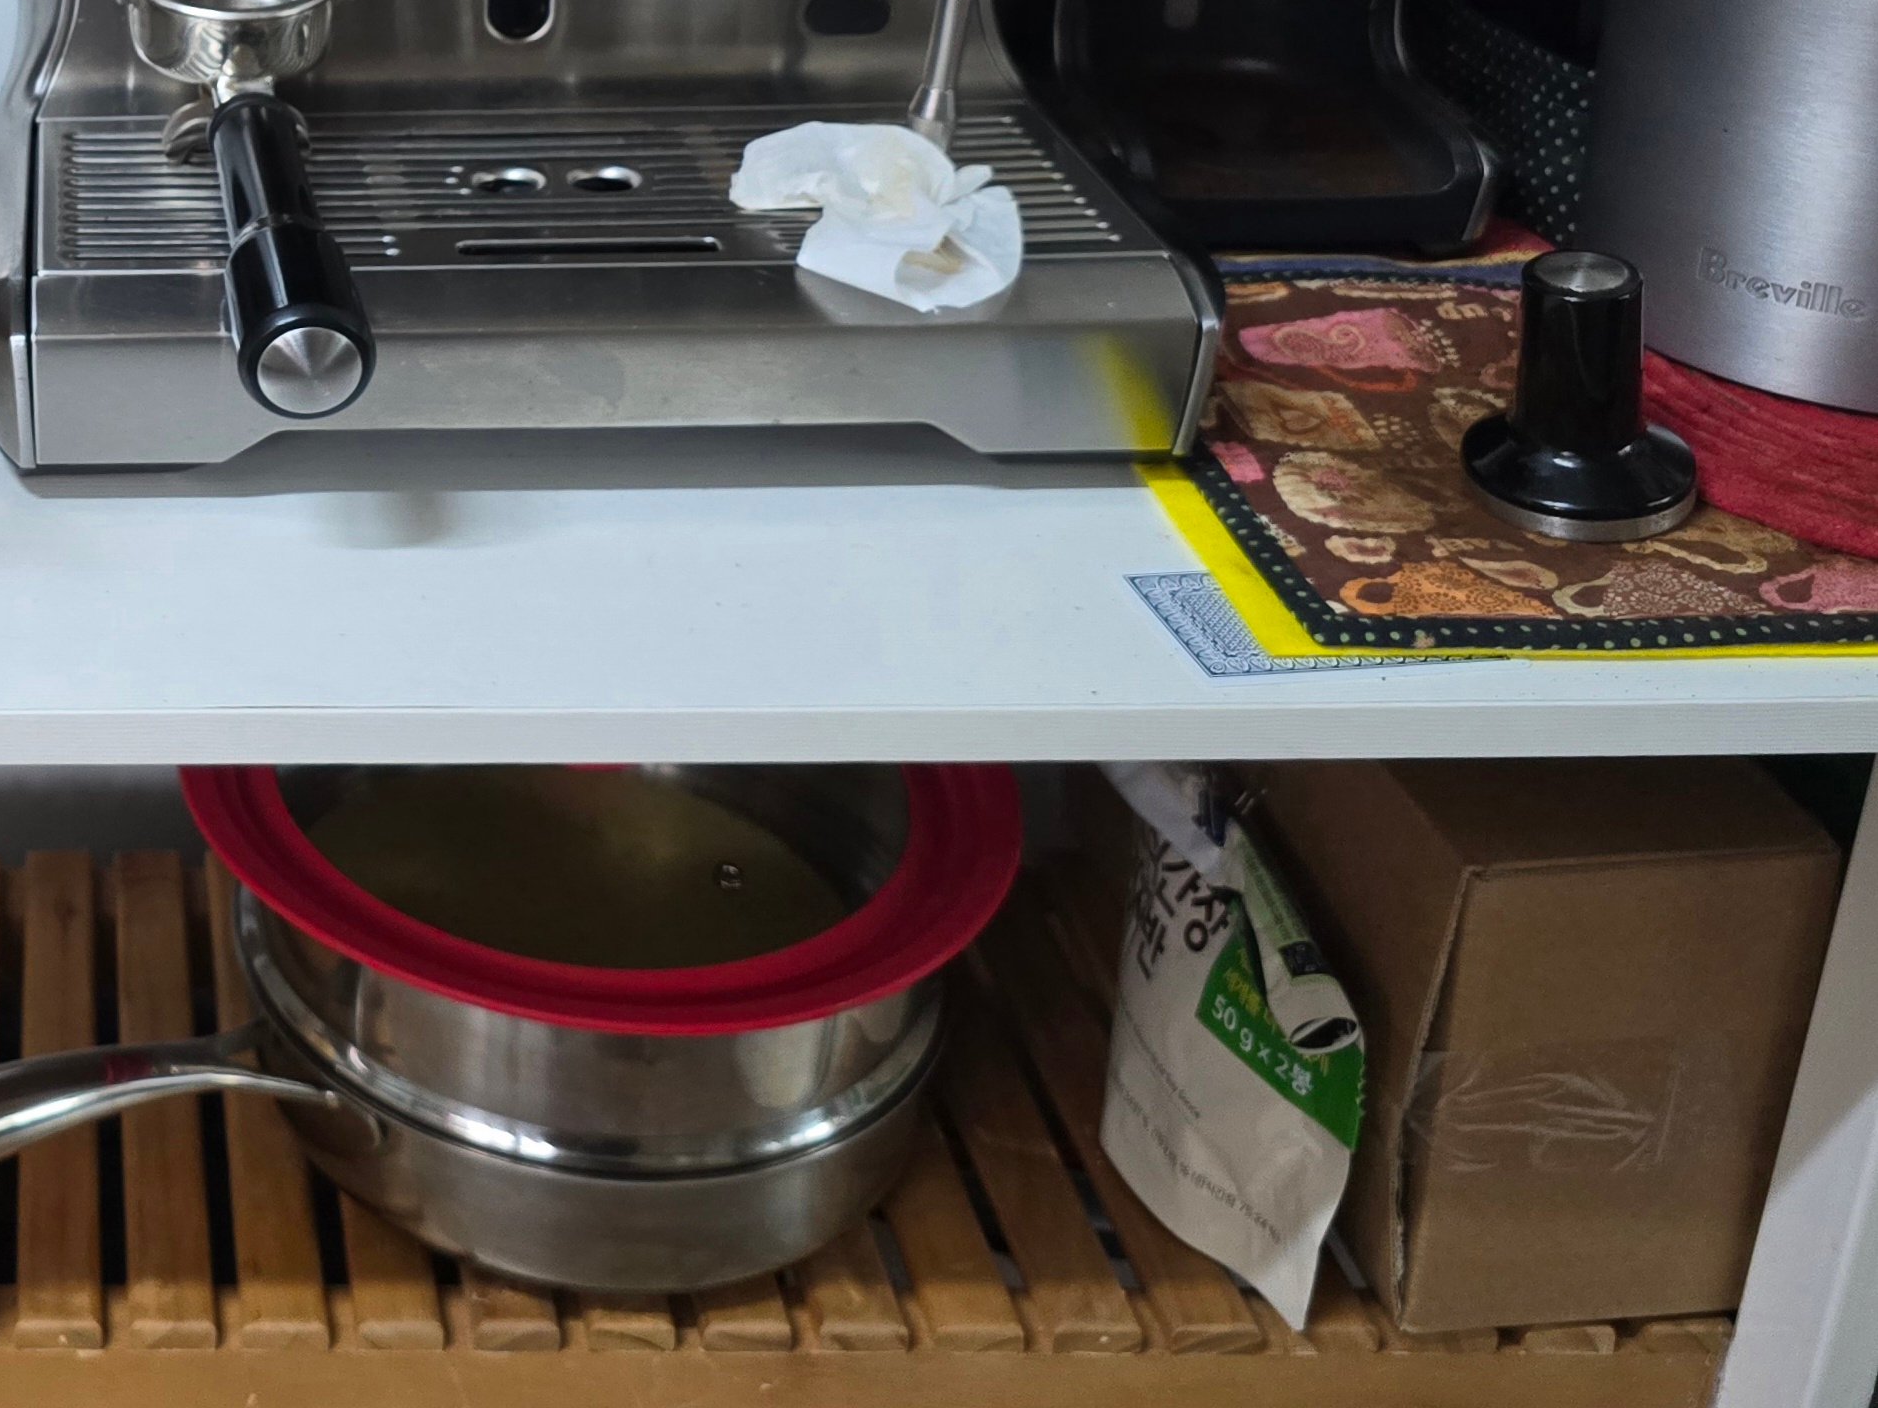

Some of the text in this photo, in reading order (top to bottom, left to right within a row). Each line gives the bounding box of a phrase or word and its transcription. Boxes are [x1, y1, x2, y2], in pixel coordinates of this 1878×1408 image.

[1696, 246, 1867, 320] Breville
[1211, 994, 1237, 1032] 50
[1239, 1026, 1253, 1053] g
